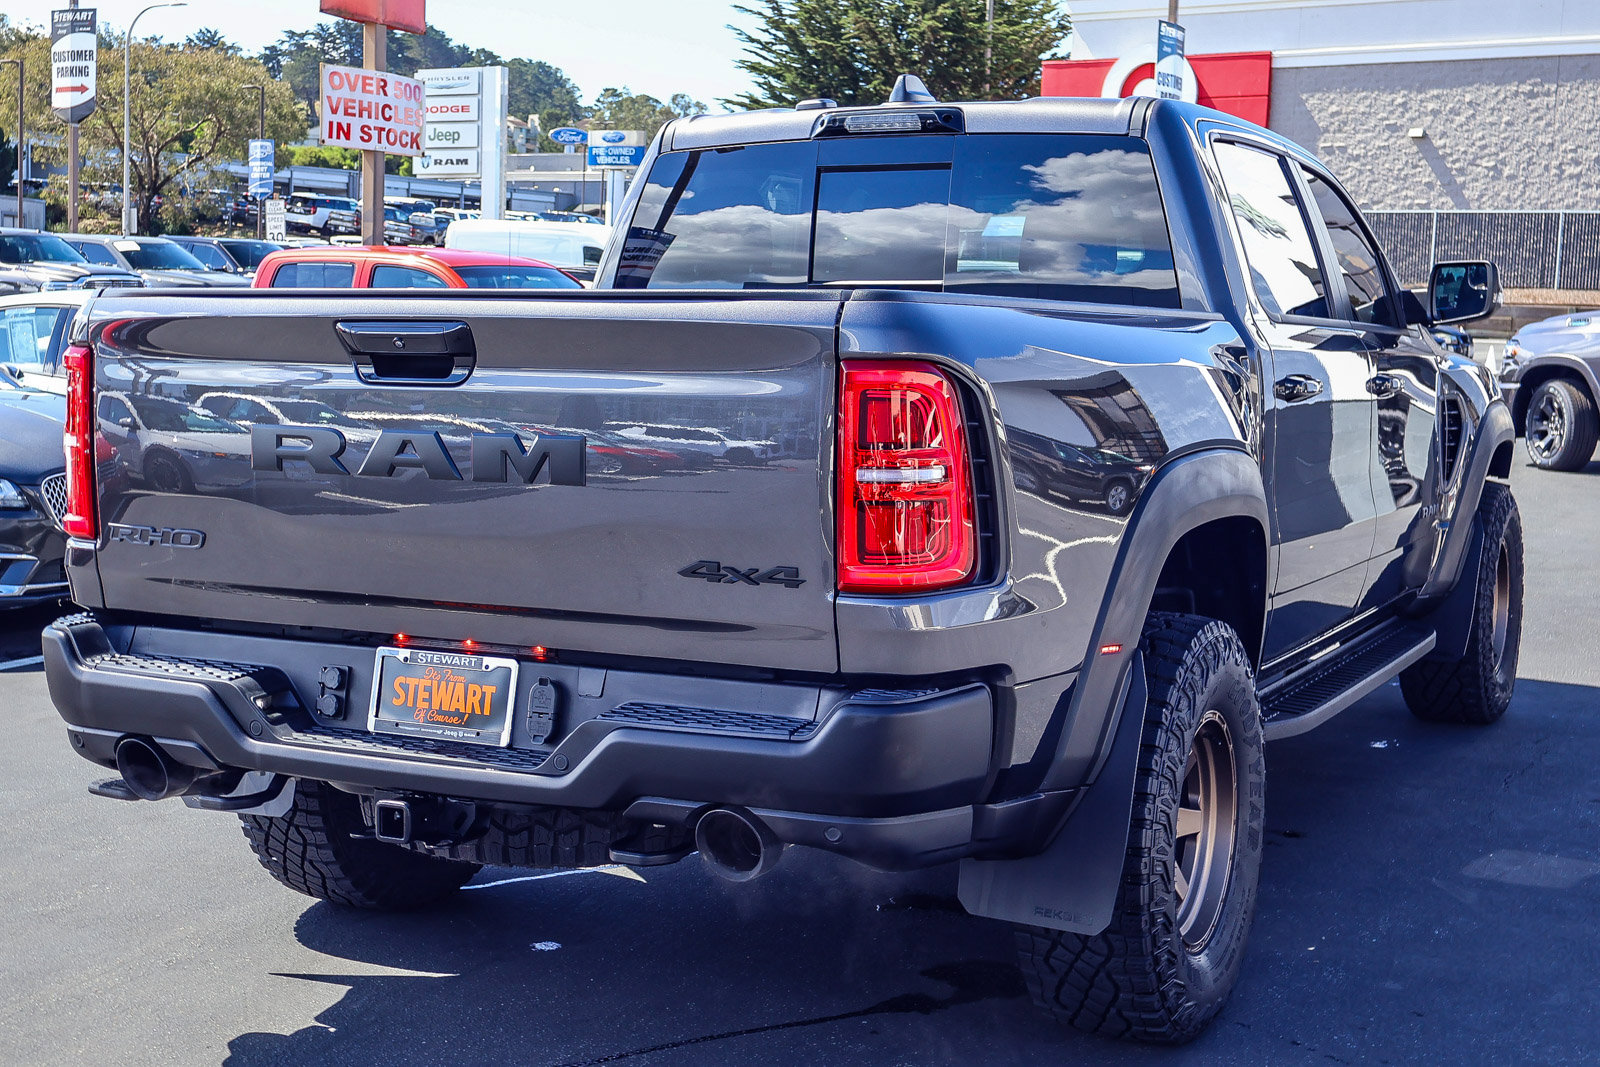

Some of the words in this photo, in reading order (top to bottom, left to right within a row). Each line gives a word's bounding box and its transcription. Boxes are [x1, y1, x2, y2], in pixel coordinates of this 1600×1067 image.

[53, 11, 93, 22] STEWART
[53, 50, 94, 63] CUSTOMER
[56, 65, 89, 78] PARKING
[328, 71, 388, 96] OVER
[394, 80, 422, 103] 500
[326, 95, 424, 127] VEHICLES
[328, 120, 351, 141] IN
[359, 124, 421, 150] STOCK
[428, 127, 460, 144] Jeep
[558, 131, 583, 142] Ford
[592, 147, 636, 156] PRE-OWNED
[433, 158, 469, 166] RAM
[596, 156, 631, 164] VEHICLES
[251, 424, 586, 486] RAM
[107, 522, 206, 549] RHO
[677, 560, 807, 588] 4x4
[417, 653, 478, 667] STEWART
[443, 669, 467, 682] From
[392, 675, 497, 716] STEWART
